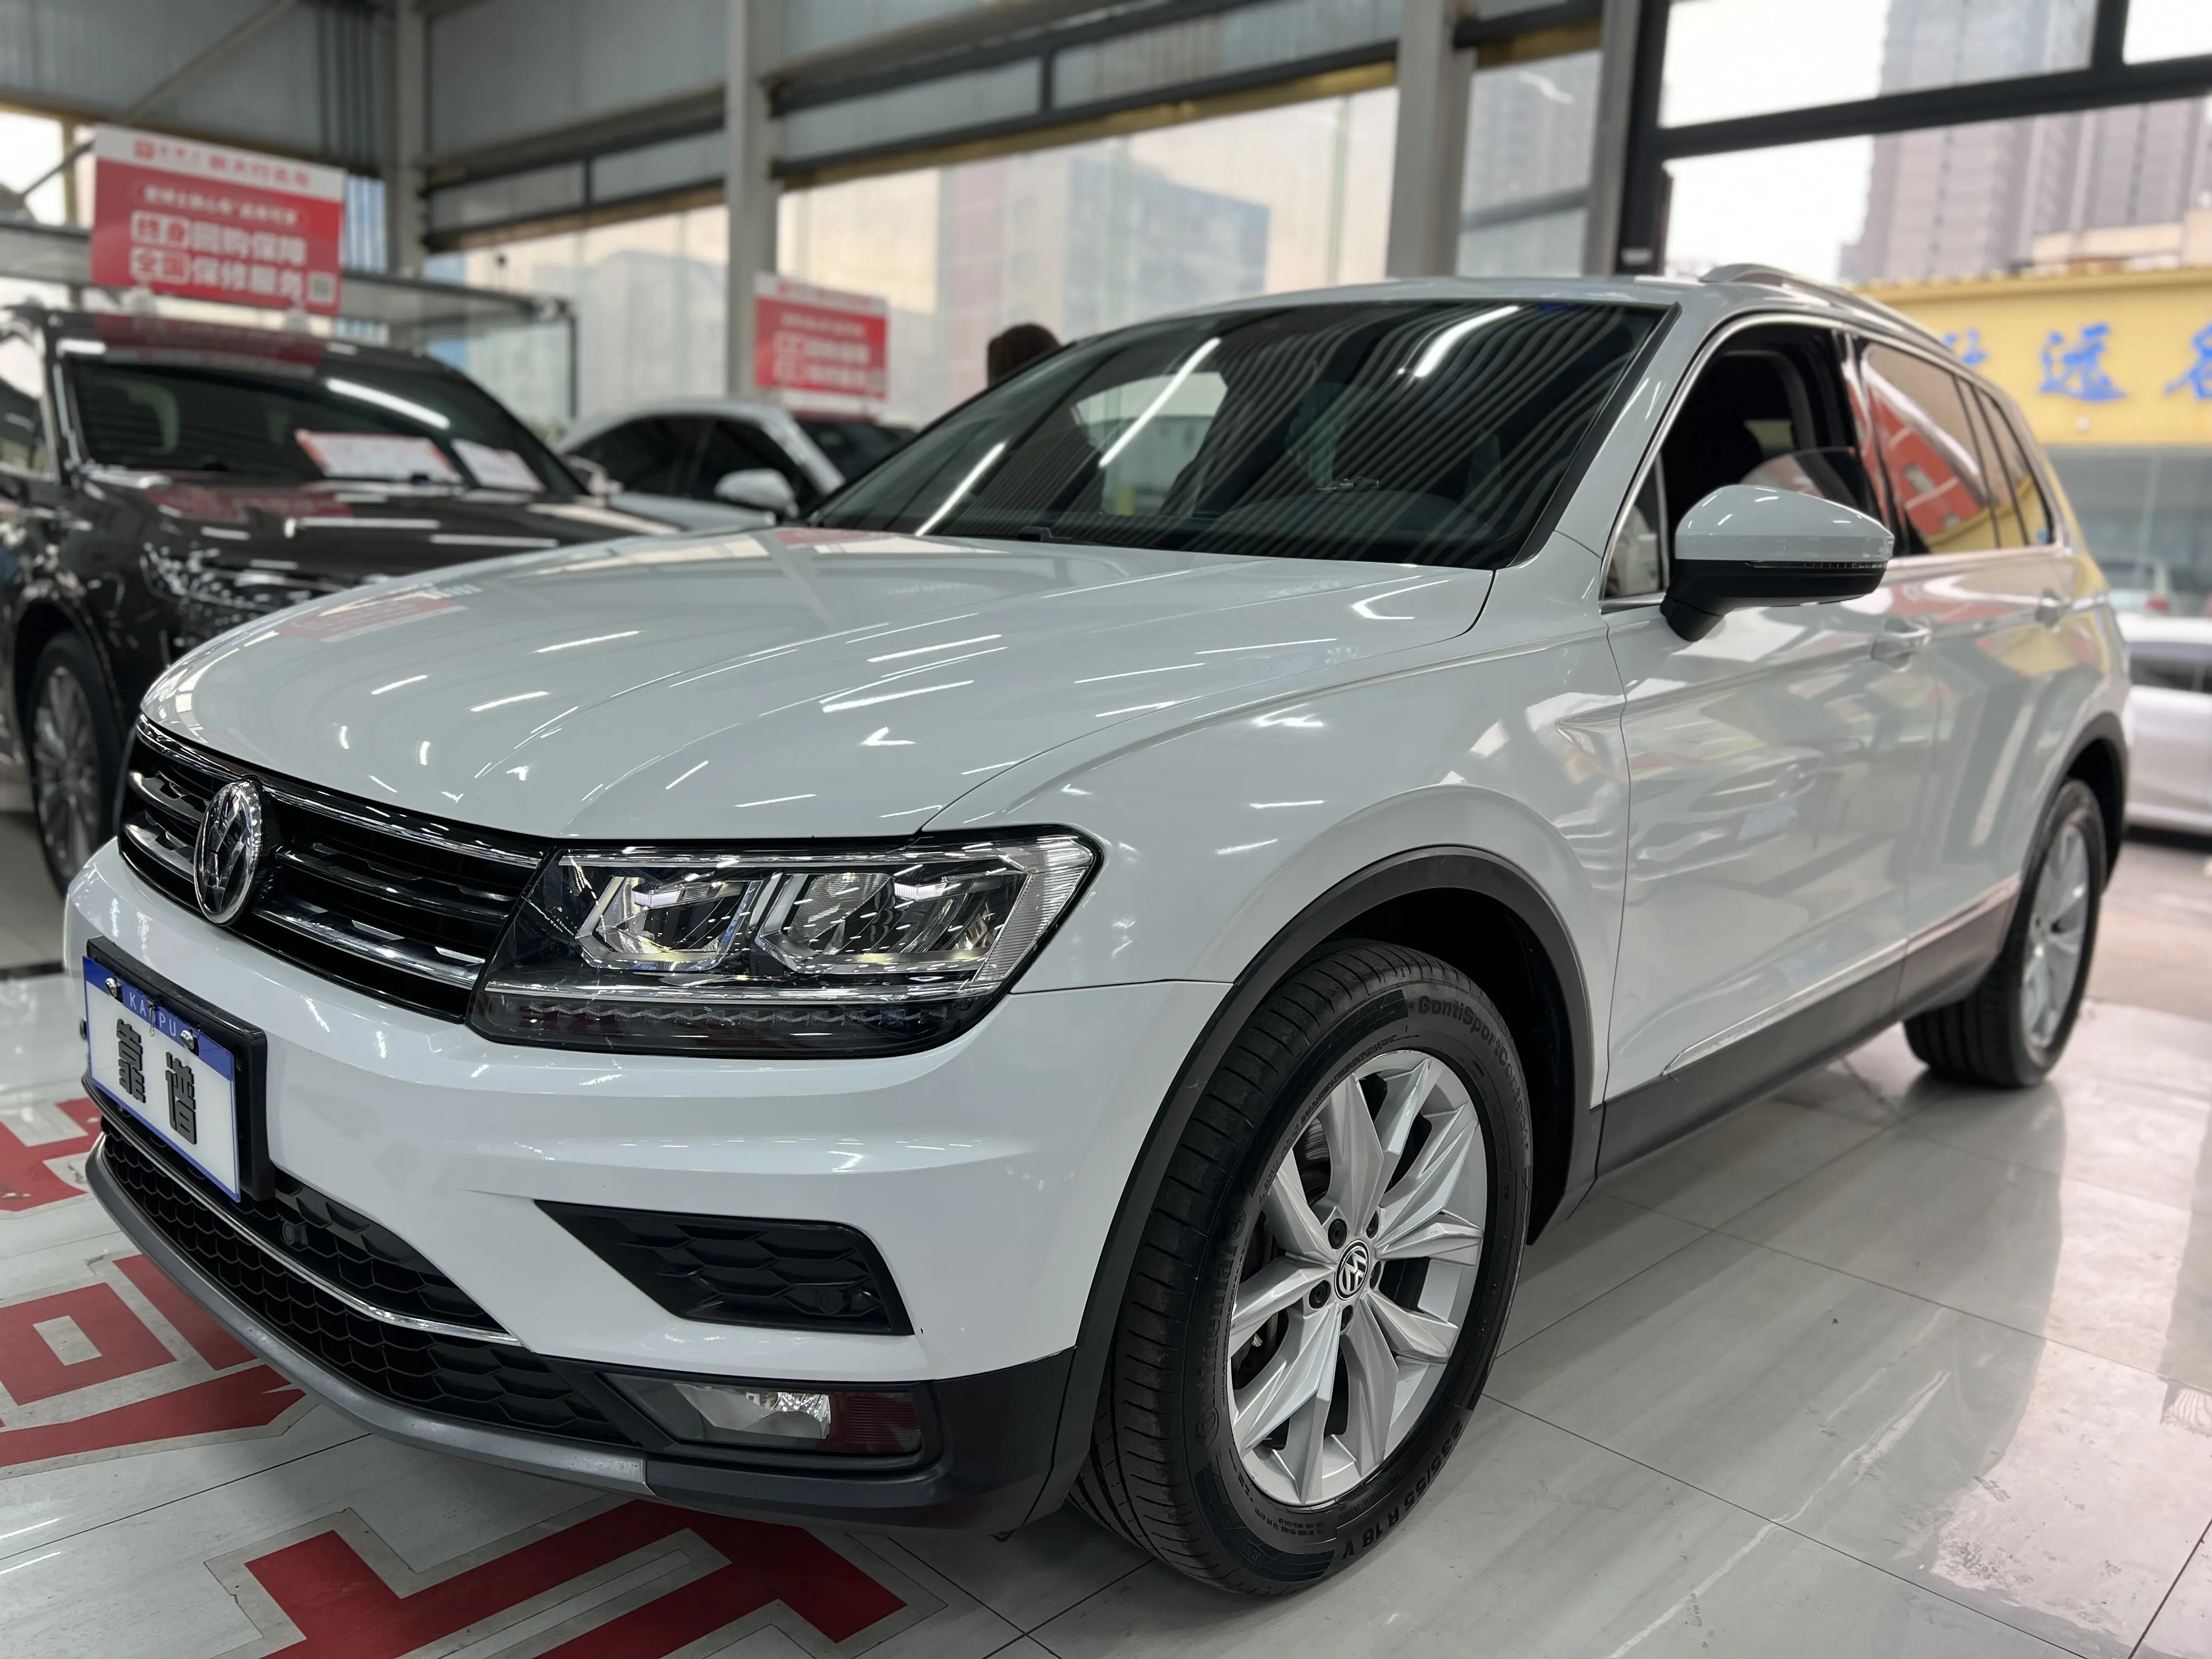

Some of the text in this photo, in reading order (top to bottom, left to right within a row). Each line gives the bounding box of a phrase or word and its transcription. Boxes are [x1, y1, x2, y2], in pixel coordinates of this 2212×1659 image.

[116, 1018, 196, 1146] 靠谱
[1335, 1240, 1369, 1298] VW
[1404, 1420, 1462, 1512] 235/55
[1362, 1524, 1383, 1549] 18
[1388, 1506, 1399, 1526] R
[1341, 1539, 1355, 1561] V
